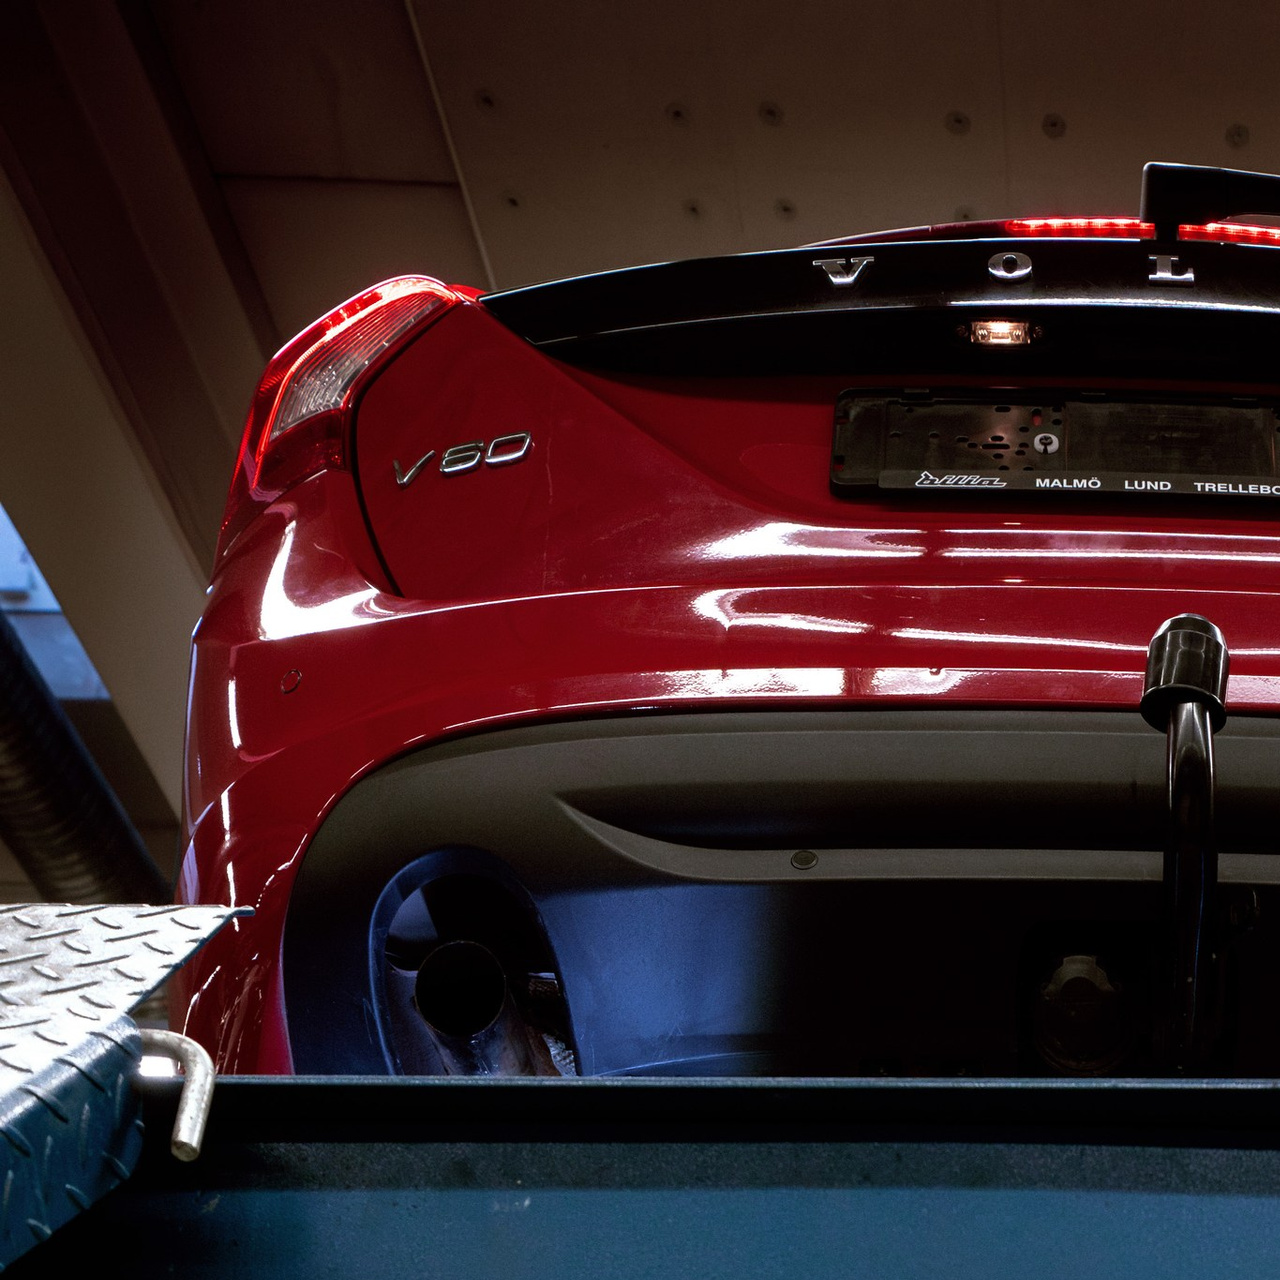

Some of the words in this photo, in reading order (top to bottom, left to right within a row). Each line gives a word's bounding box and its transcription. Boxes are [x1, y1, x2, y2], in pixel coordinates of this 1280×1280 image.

[393, 431, 531, 487] V60
[1035, 477, 1101, 489] MALMÖ
[1124, 480, 1171, 491] LUND
